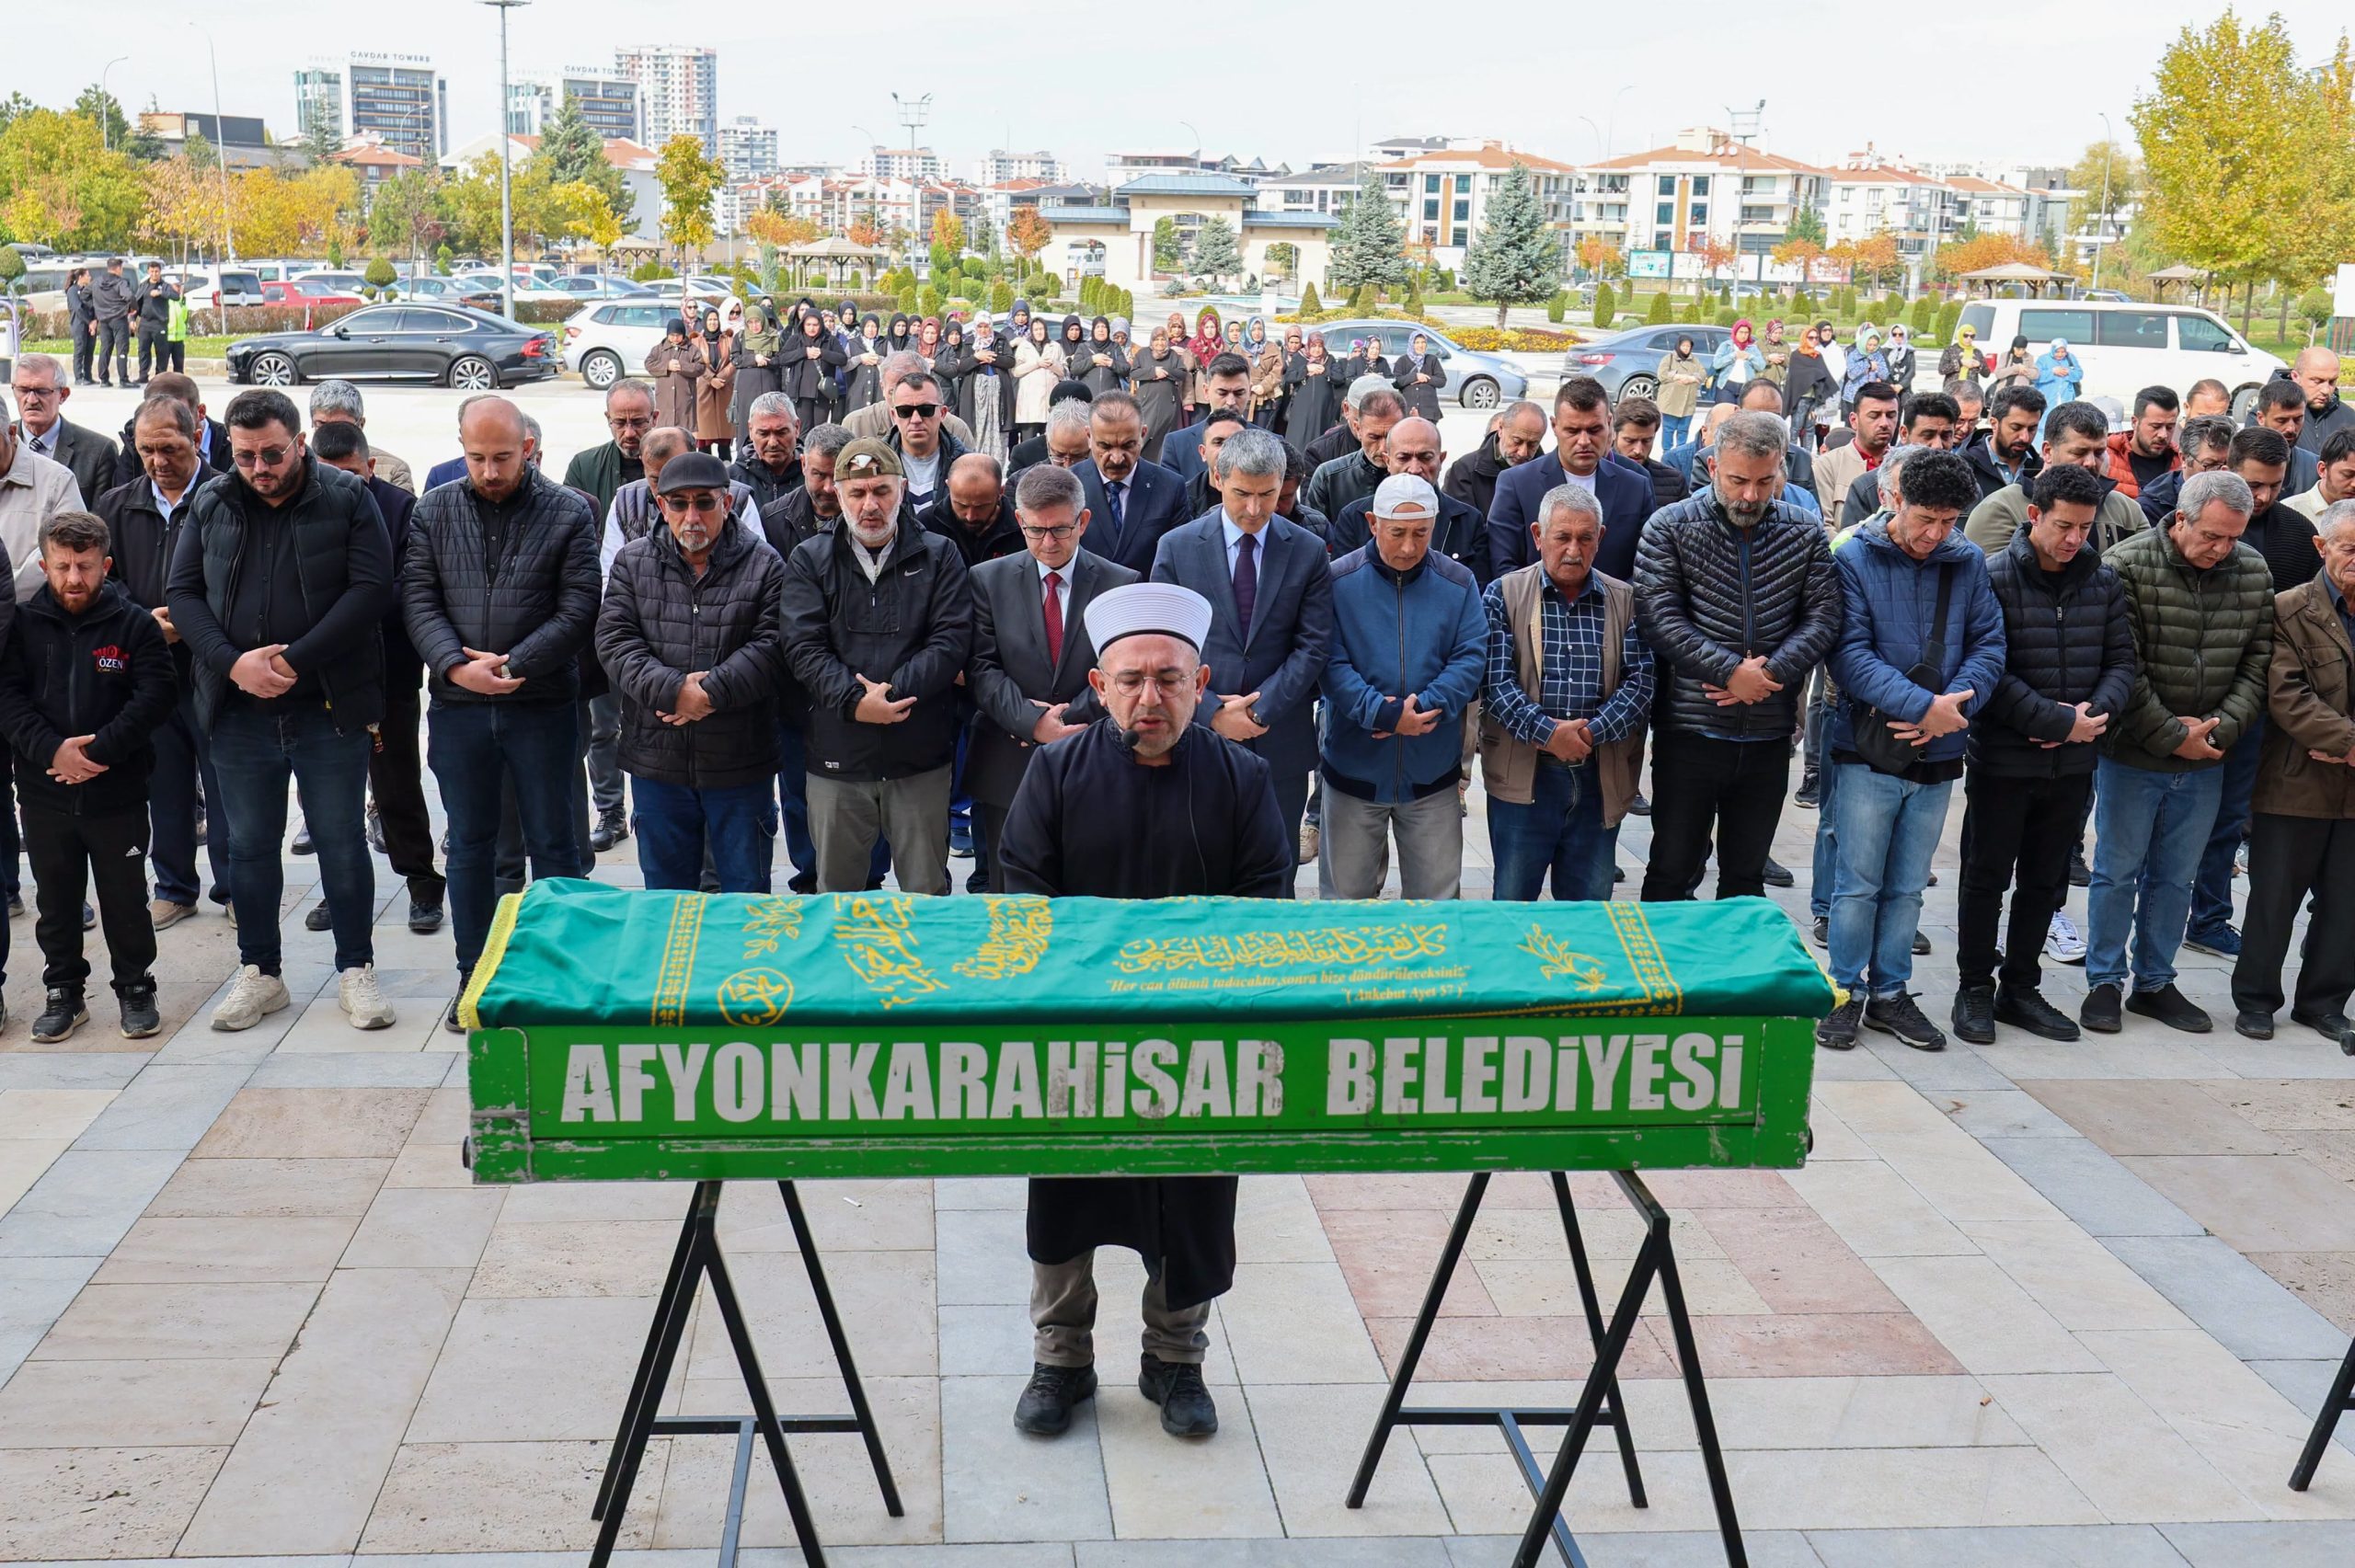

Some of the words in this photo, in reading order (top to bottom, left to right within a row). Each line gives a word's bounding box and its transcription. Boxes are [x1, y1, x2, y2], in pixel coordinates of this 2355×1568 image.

[394, 53, 431, 63] TOWERS
[98, 656, 123, 670] ÖZEN
[1140, 981, 1164, 991] can
[1167, 978, 1209, 990] ölümü
[1321, 970, 1346, 984] bize
[1354, 987, 1407, 1001] Ankebut
[1409, 987, 1436, 1001] Ayet
